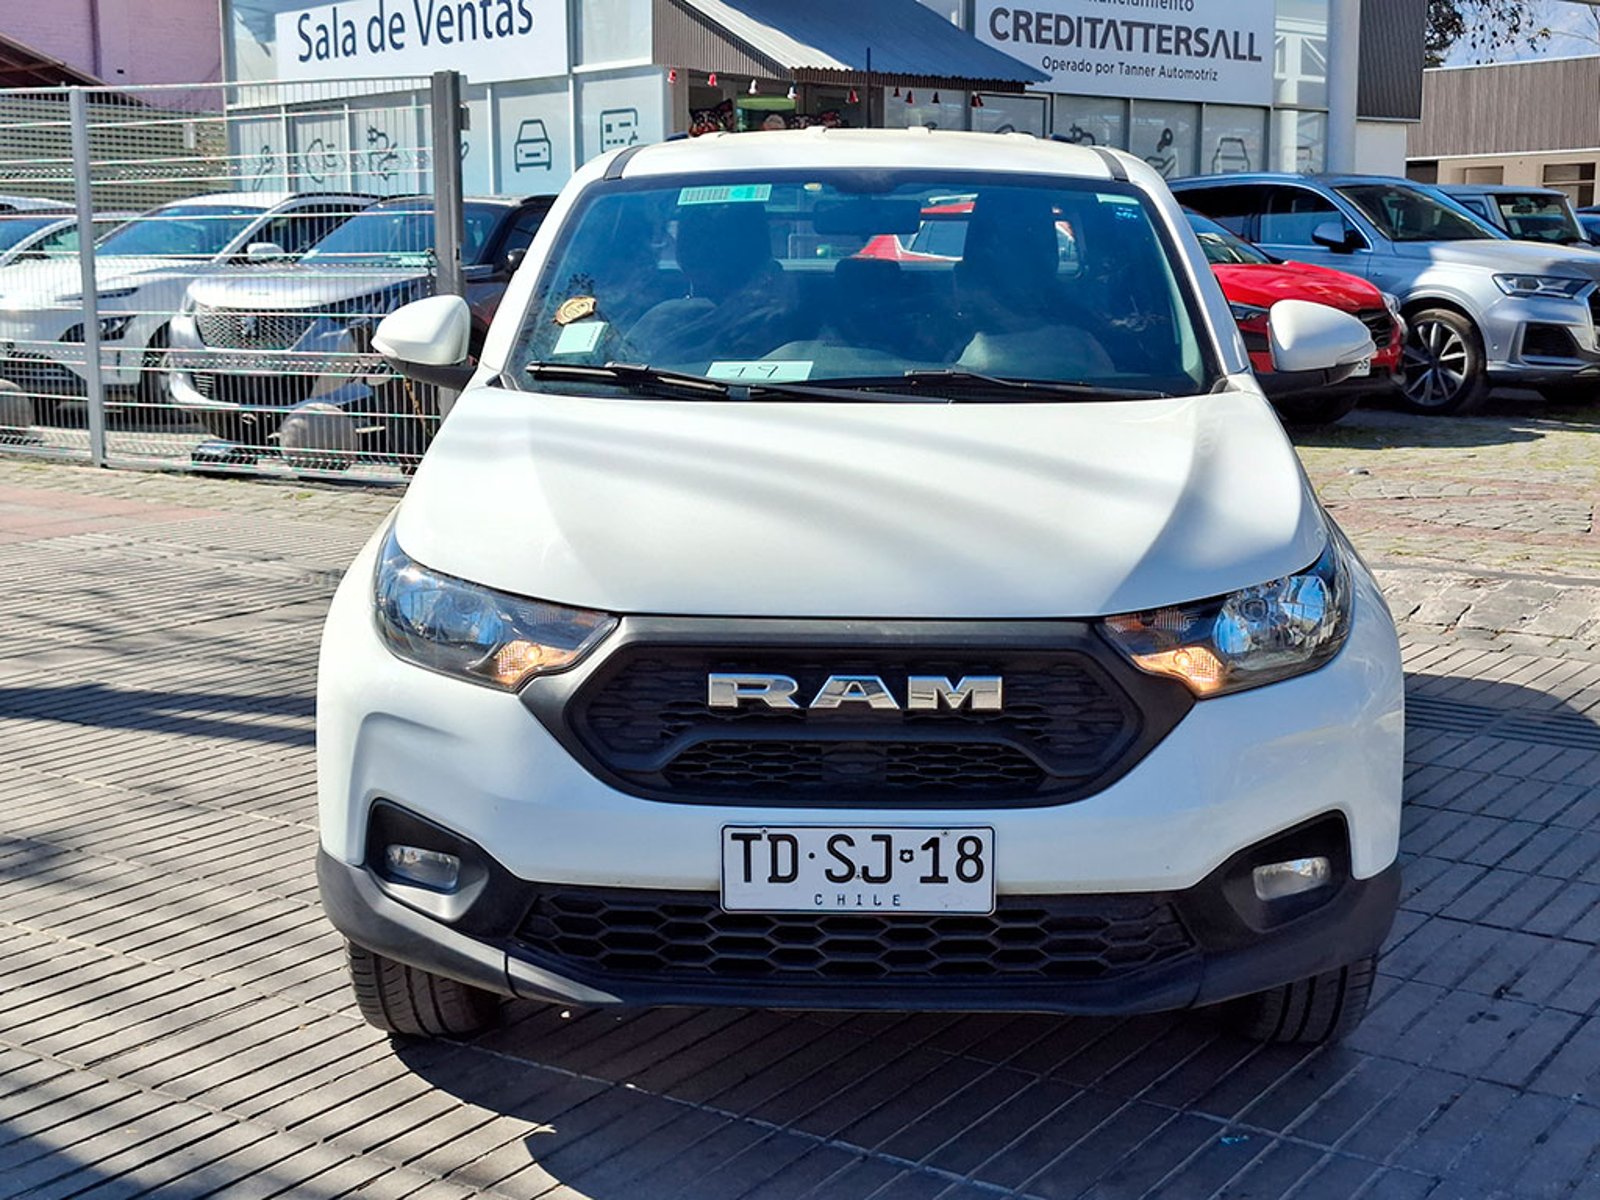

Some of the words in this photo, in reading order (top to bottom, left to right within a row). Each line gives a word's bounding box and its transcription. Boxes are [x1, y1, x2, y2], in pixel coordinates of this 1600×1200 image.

[297, 6, 357, 62] Sala
[367, 0, 406, 52] de
[412, 0, 534, 46] Ventas
[989, 7, 1263, 62] CREDITATTERSALL
[1042, 55, 1092, 74] Operado
[1095, 62, 1115, 76] por
[1118, 61, 1155, 77] Tanner
[1158, 64, 1218, 82] Automotriz
[708, 673, 1003, 710] RAM
[814, 893, 901, 907] CHILE
